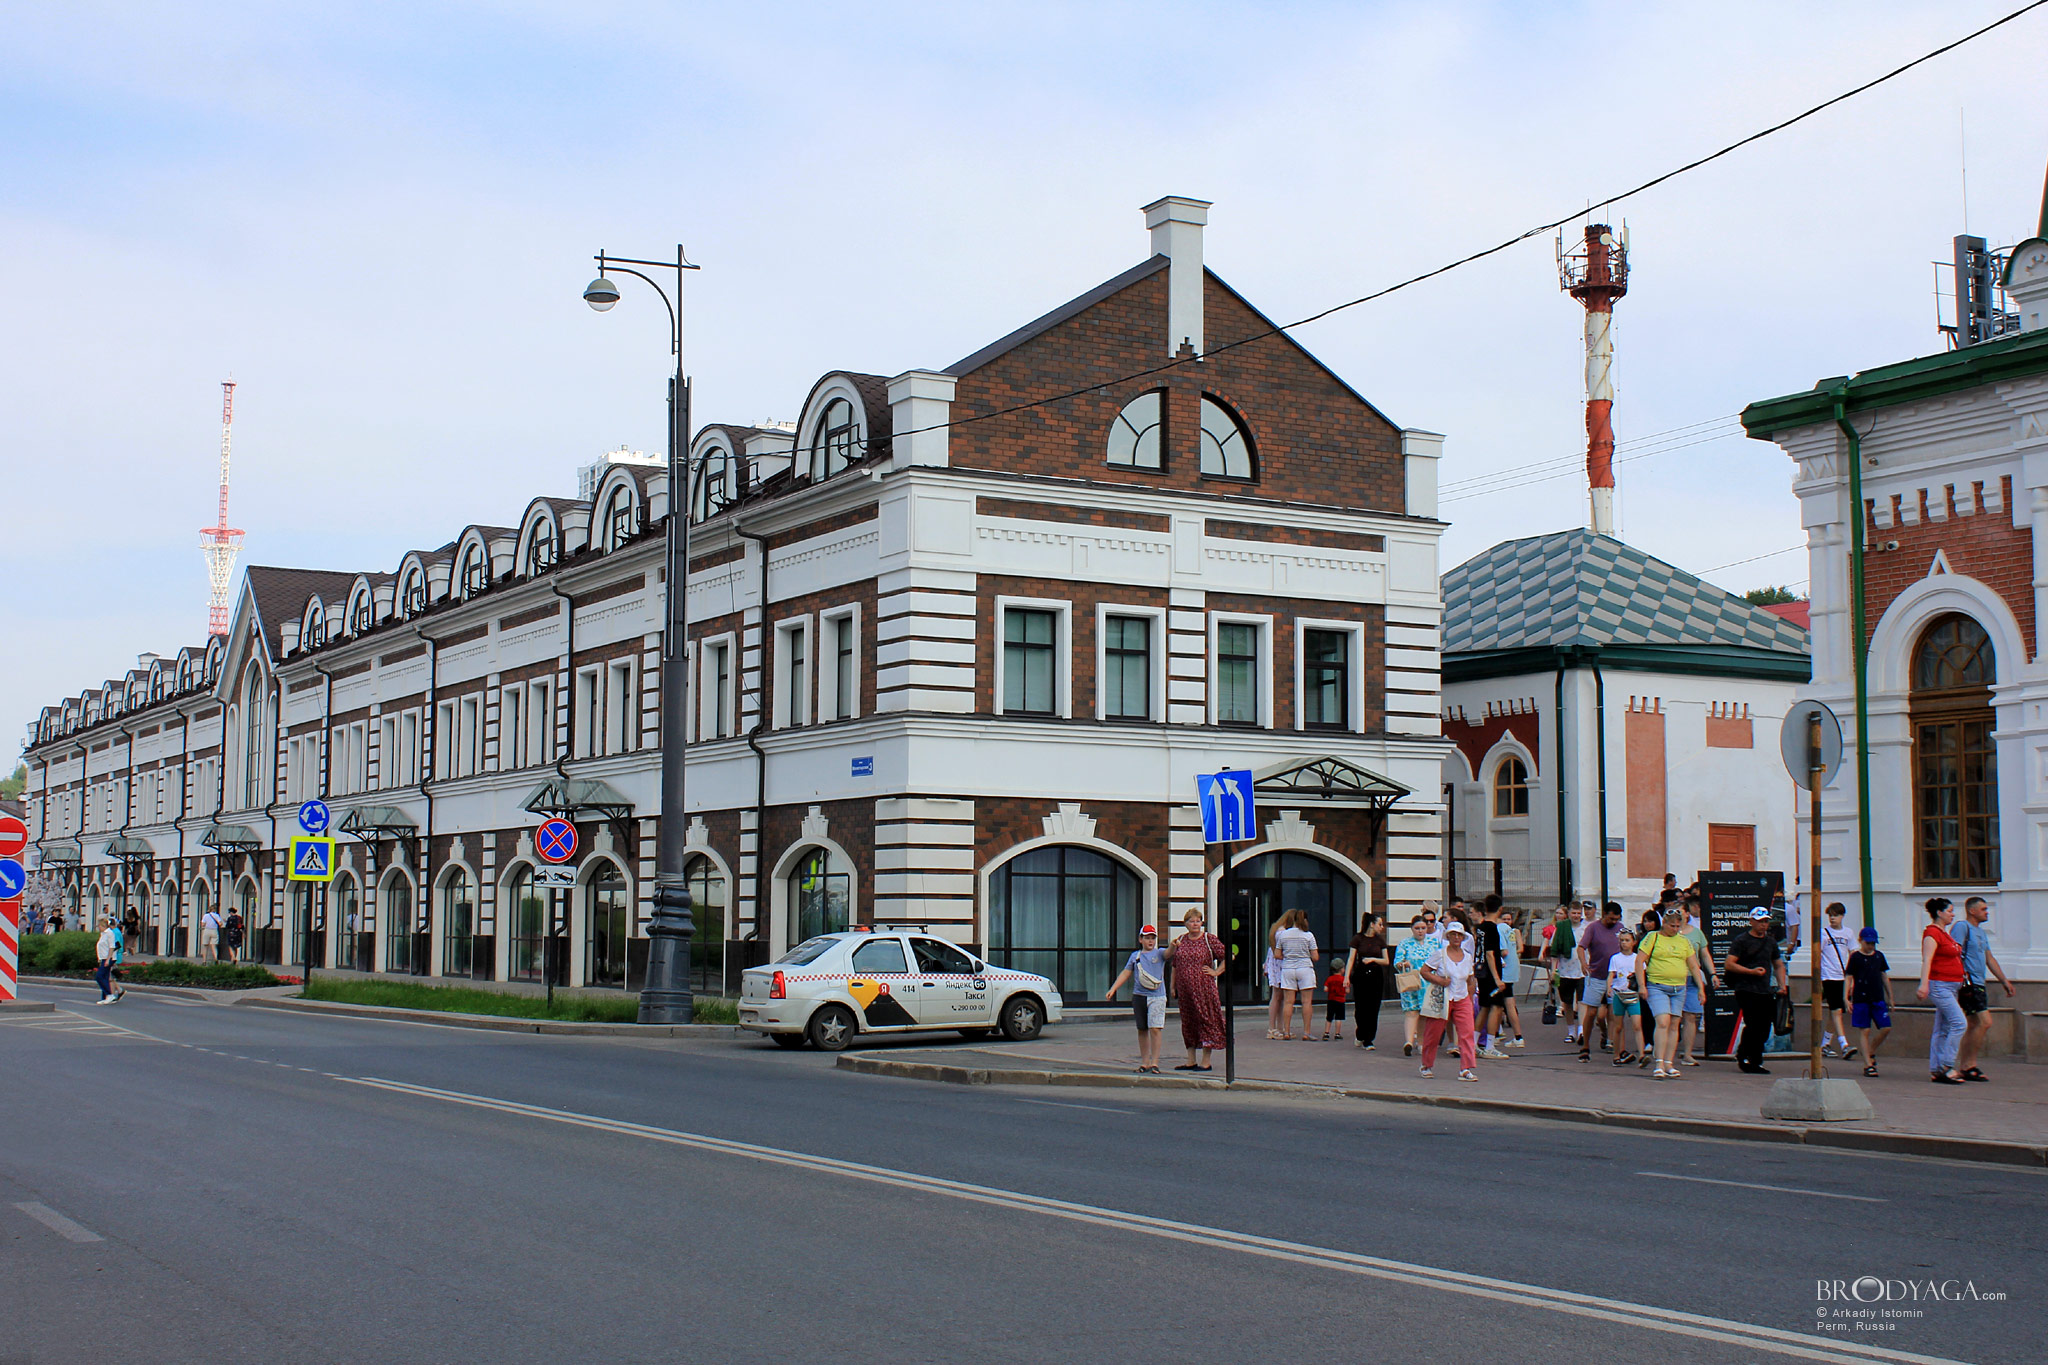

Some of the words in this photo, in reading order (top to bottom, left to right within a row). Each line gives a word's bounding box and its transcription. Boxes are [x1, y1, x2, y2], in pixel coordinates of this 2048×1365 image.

[1712, 919, 1730, 927] СВОЙ
[945, 981, 972, 989] Яндекс
[974, 980, 986, 989] Go
[902, 985, 916, 993] 414
[964, 991, 986, 1000] Такси
